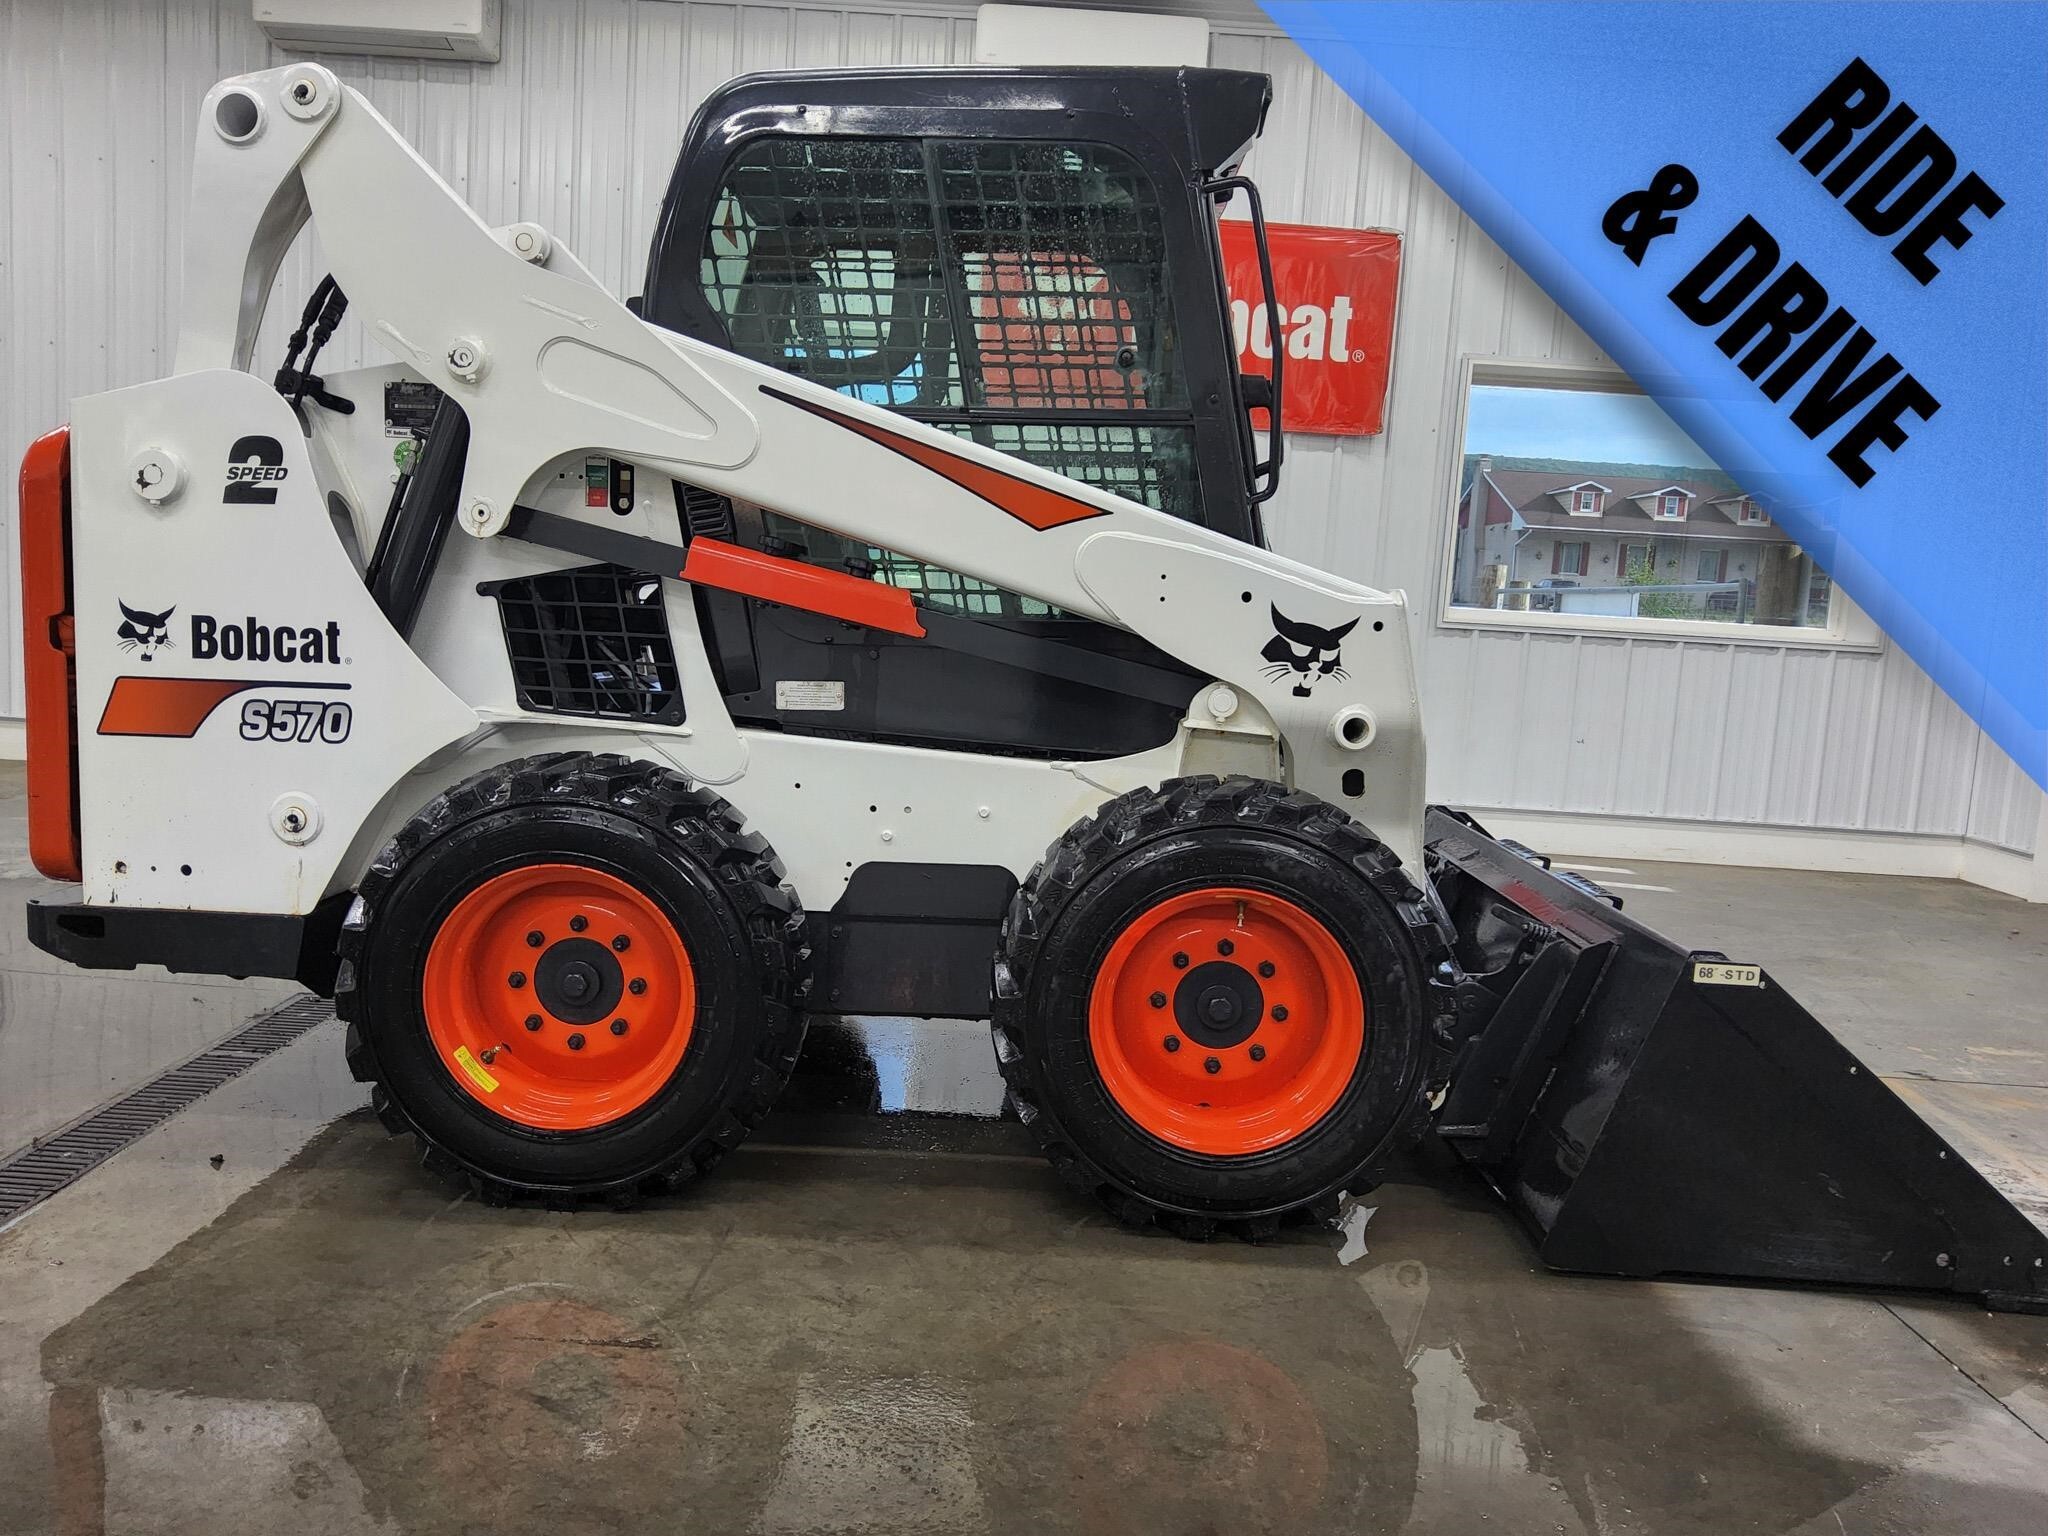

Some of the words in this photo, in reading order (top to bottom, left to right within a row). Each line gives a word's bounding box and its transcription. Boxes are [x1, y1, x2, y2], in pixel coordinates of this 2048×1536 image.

[222, 435, 284, 505] 2
[226, 466, 289, 481] SPEED
[191, 614, 341, 665] Bobcat
[239, 698, 353, 745] S570
